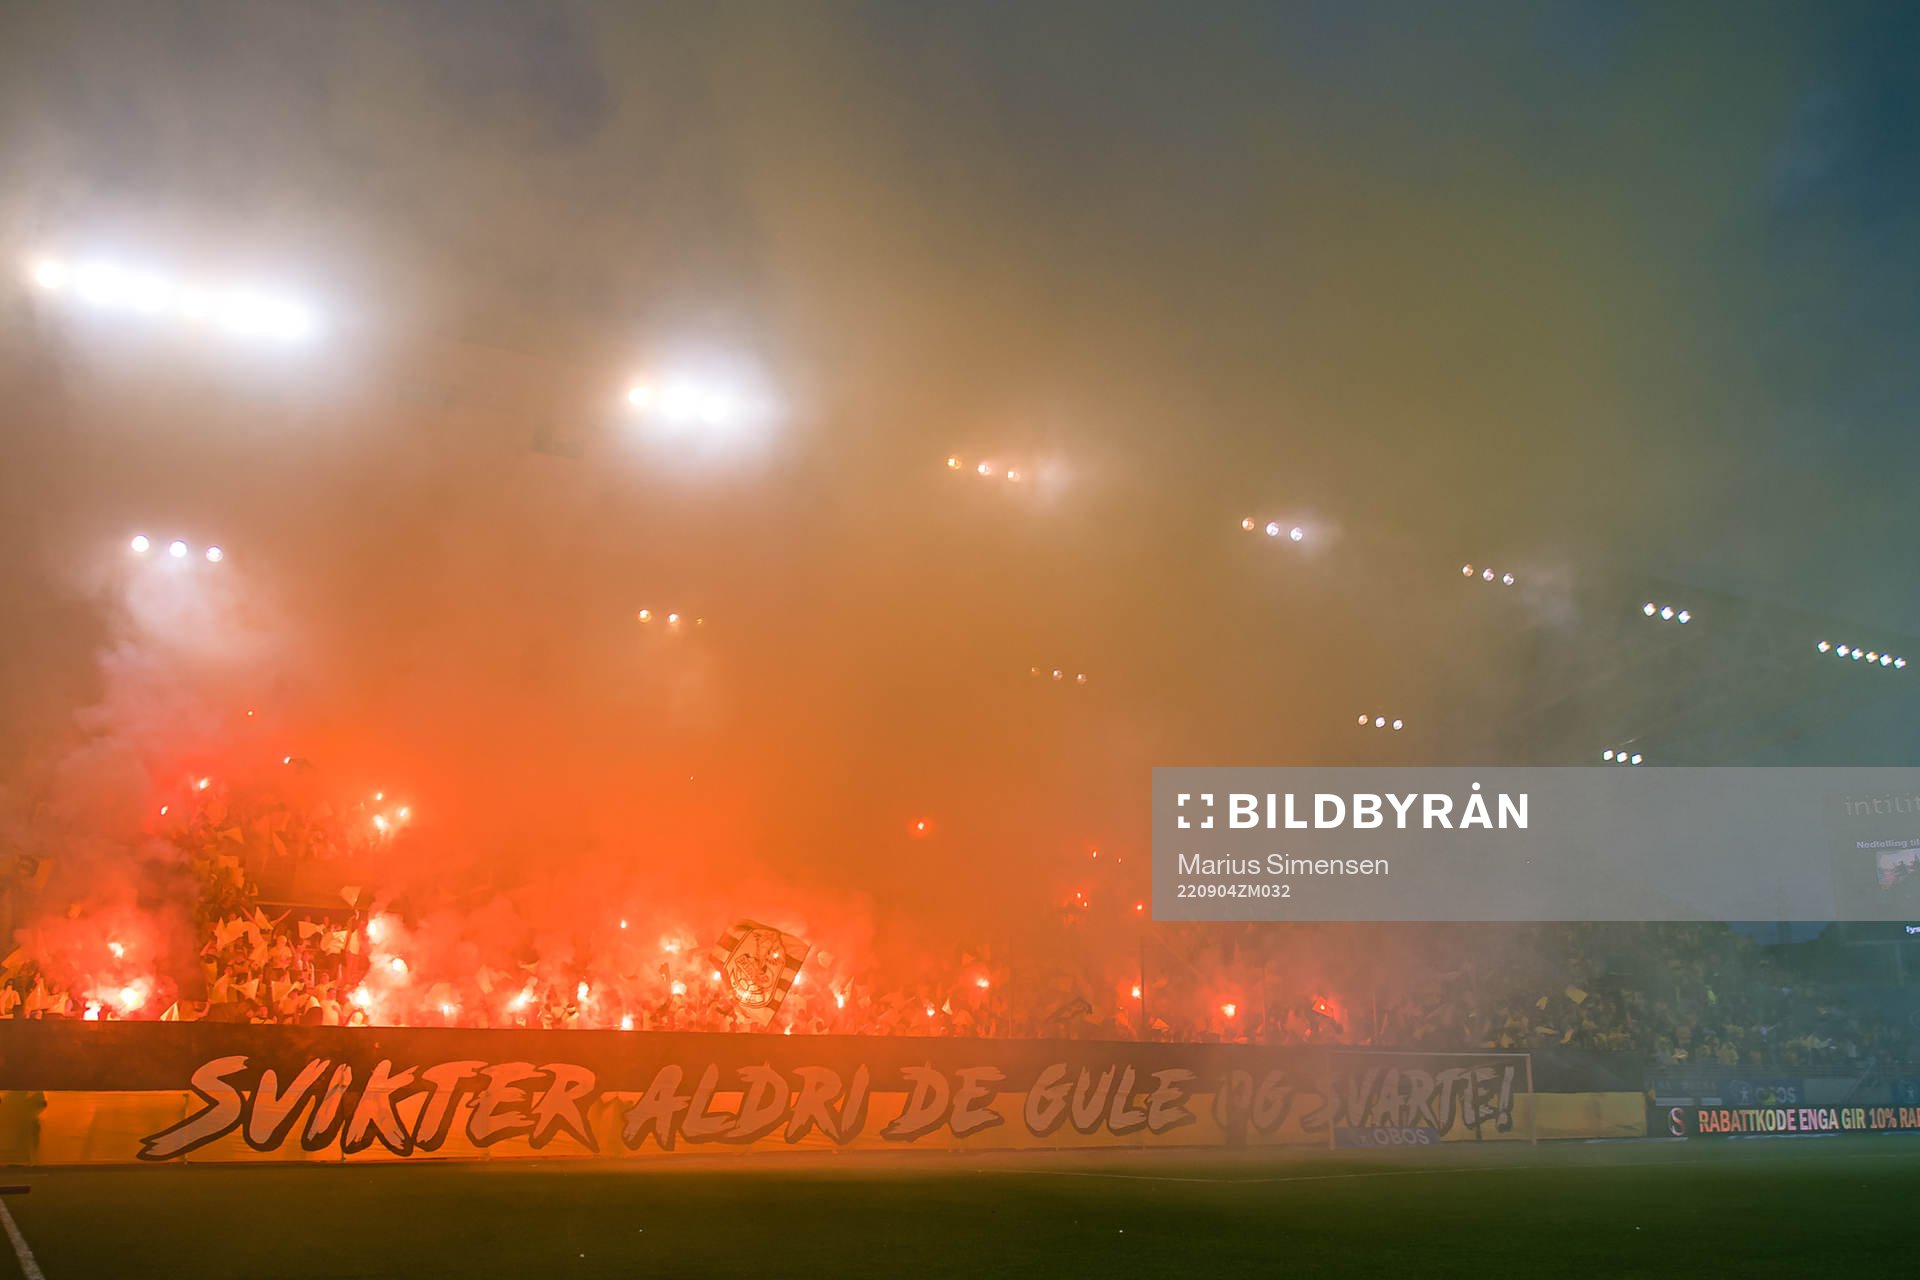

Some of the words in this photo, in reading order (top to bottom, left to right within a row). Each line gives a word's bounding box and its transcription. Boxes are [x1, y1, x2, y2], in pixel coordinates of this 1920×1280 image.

[136, 1055, 599, 1161] SVIKTER
[622, 1061, 870, 1152] ALDRI
[880, 1061, 1005, 1142] DE
[1024, 1062, 1197, 1138] GULE
[1698, 1109, 1798, 1133] RABATTKODE
[1798, 1108, 1840, 1131] ENGA
[1841, 1107, 1867, 1130] GIR
[1869, 1107, 1897, 1130] 10%
[1373, 1127, 1430, 1145] OBOS
